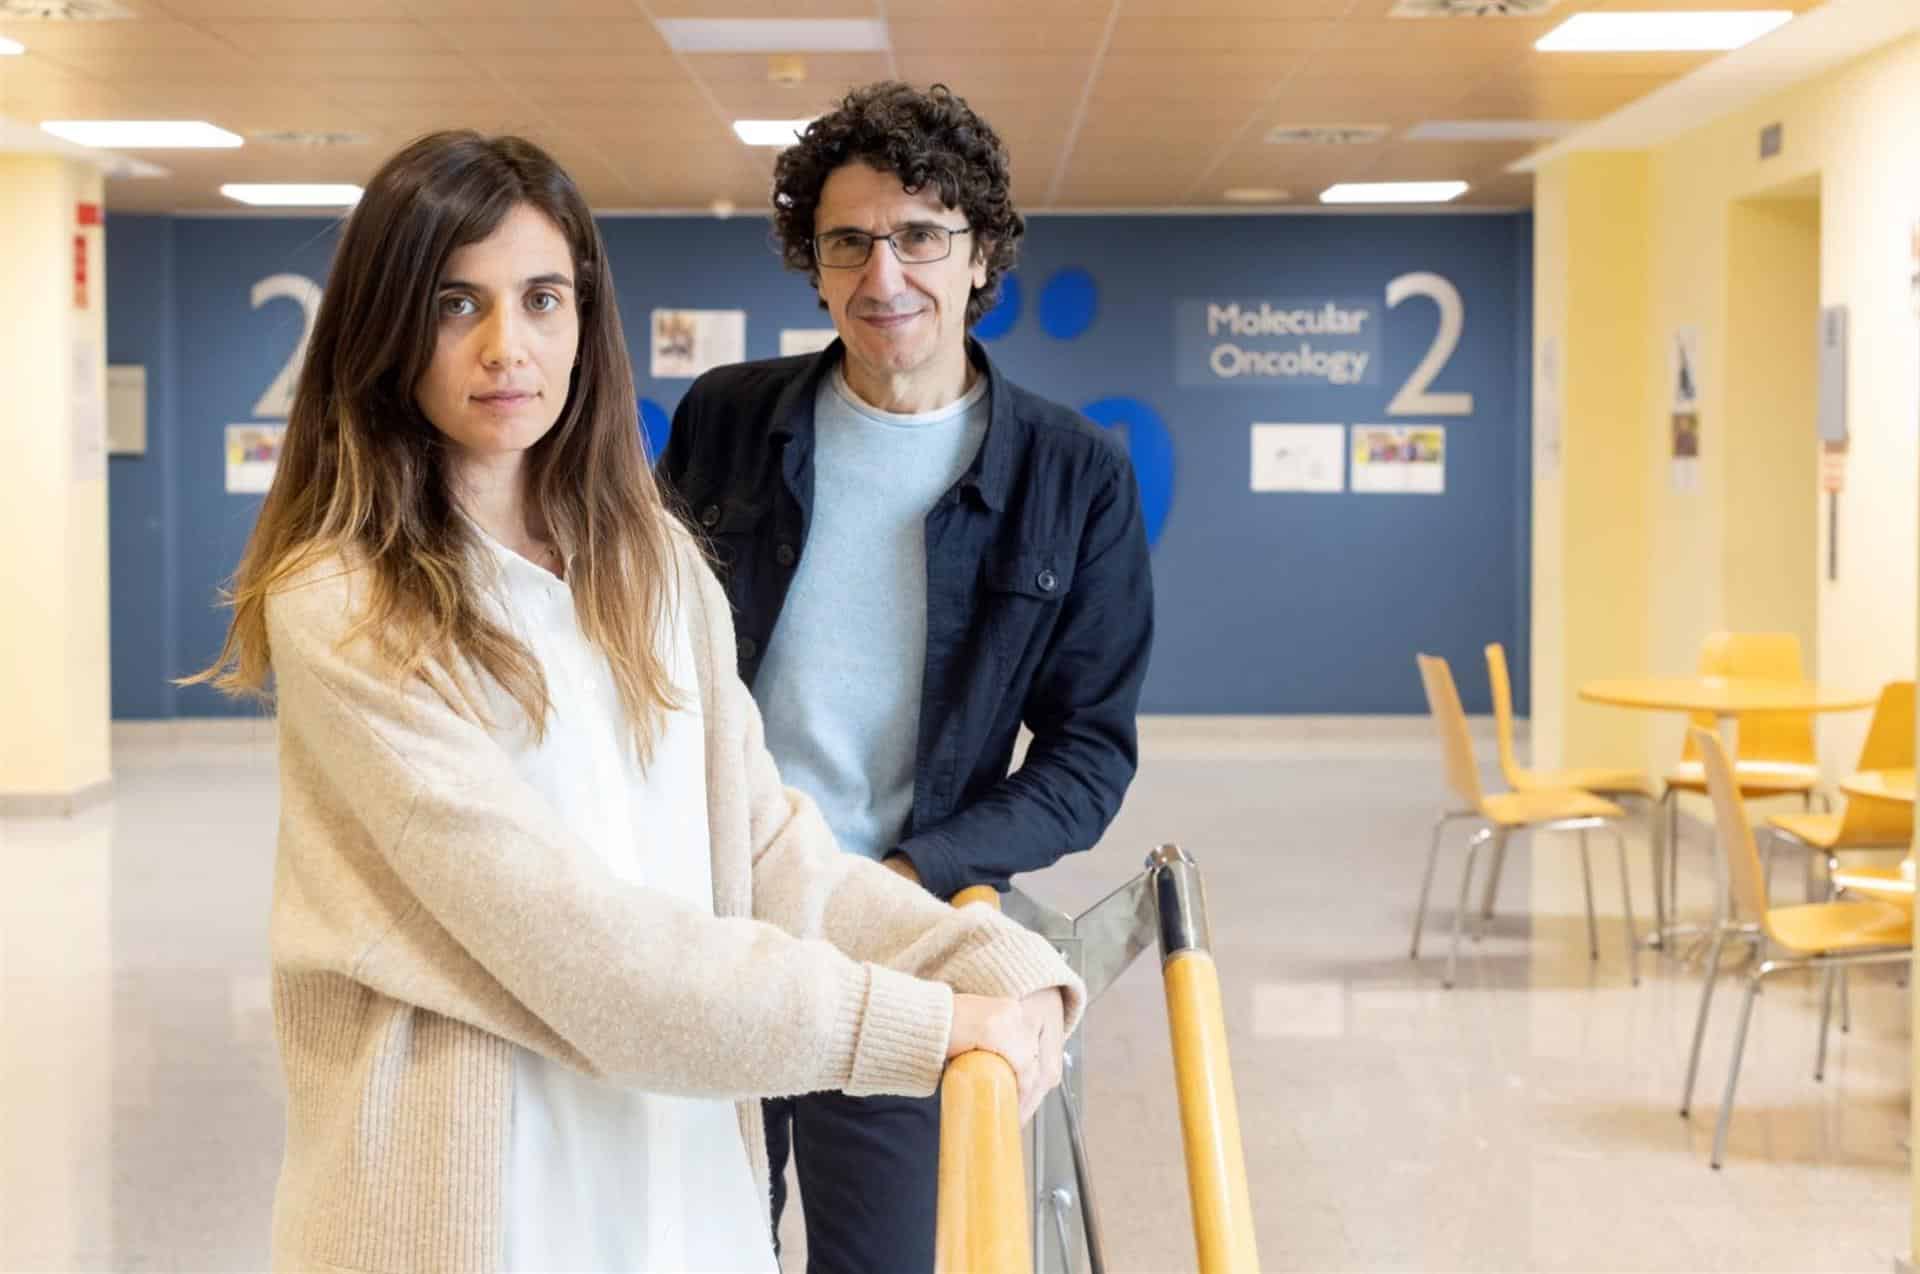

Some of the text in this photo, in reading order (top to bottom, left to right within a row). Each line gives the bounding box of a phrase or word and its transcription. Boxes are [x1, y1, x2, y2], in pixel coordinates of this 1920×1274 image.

[251, 273, 325, 417] 2
[1208, 302, 1368, 335] Molecular
[1210, 344, 1368, 384] Oncology
[1386, 272, 1473, 415] 2
